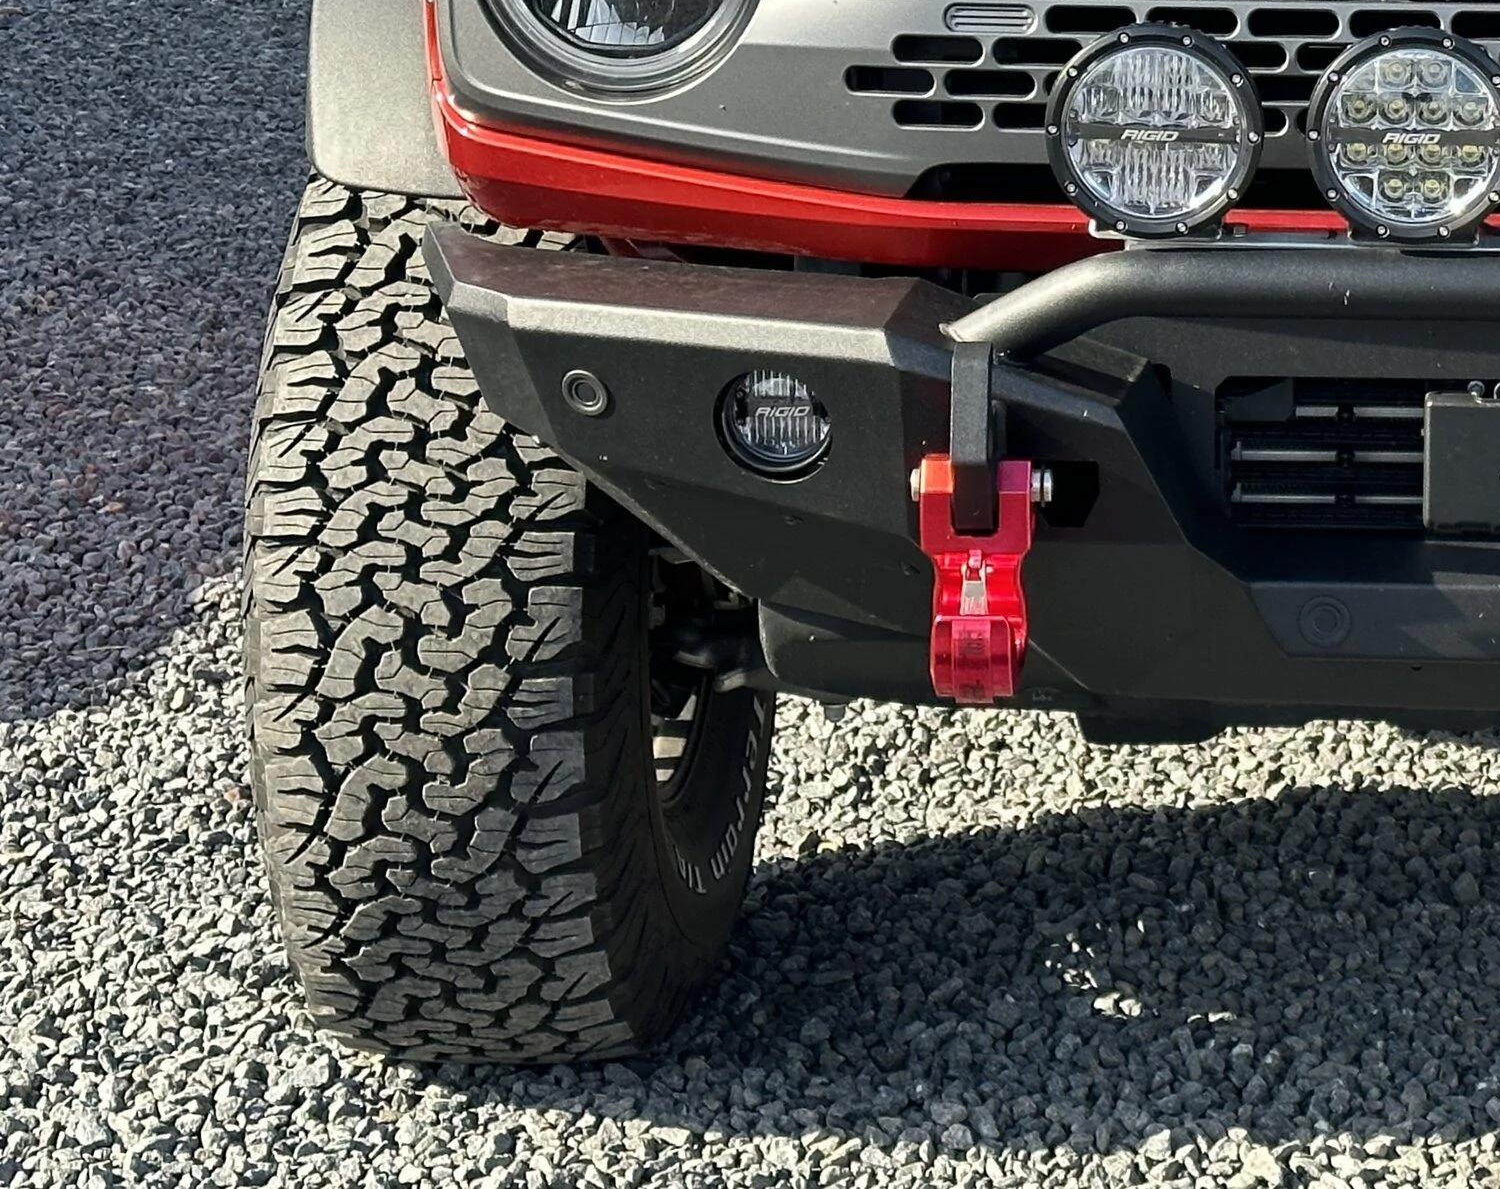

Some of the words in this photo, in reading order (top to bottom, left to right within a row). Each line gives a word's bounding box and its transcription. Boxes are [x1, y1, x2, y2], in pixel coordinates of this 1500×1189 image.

[1120, 128, 1180, 142] RIGID
[1381, 132, 1441, 145] RIGID
[755, 406, 811, 418] RIGID
